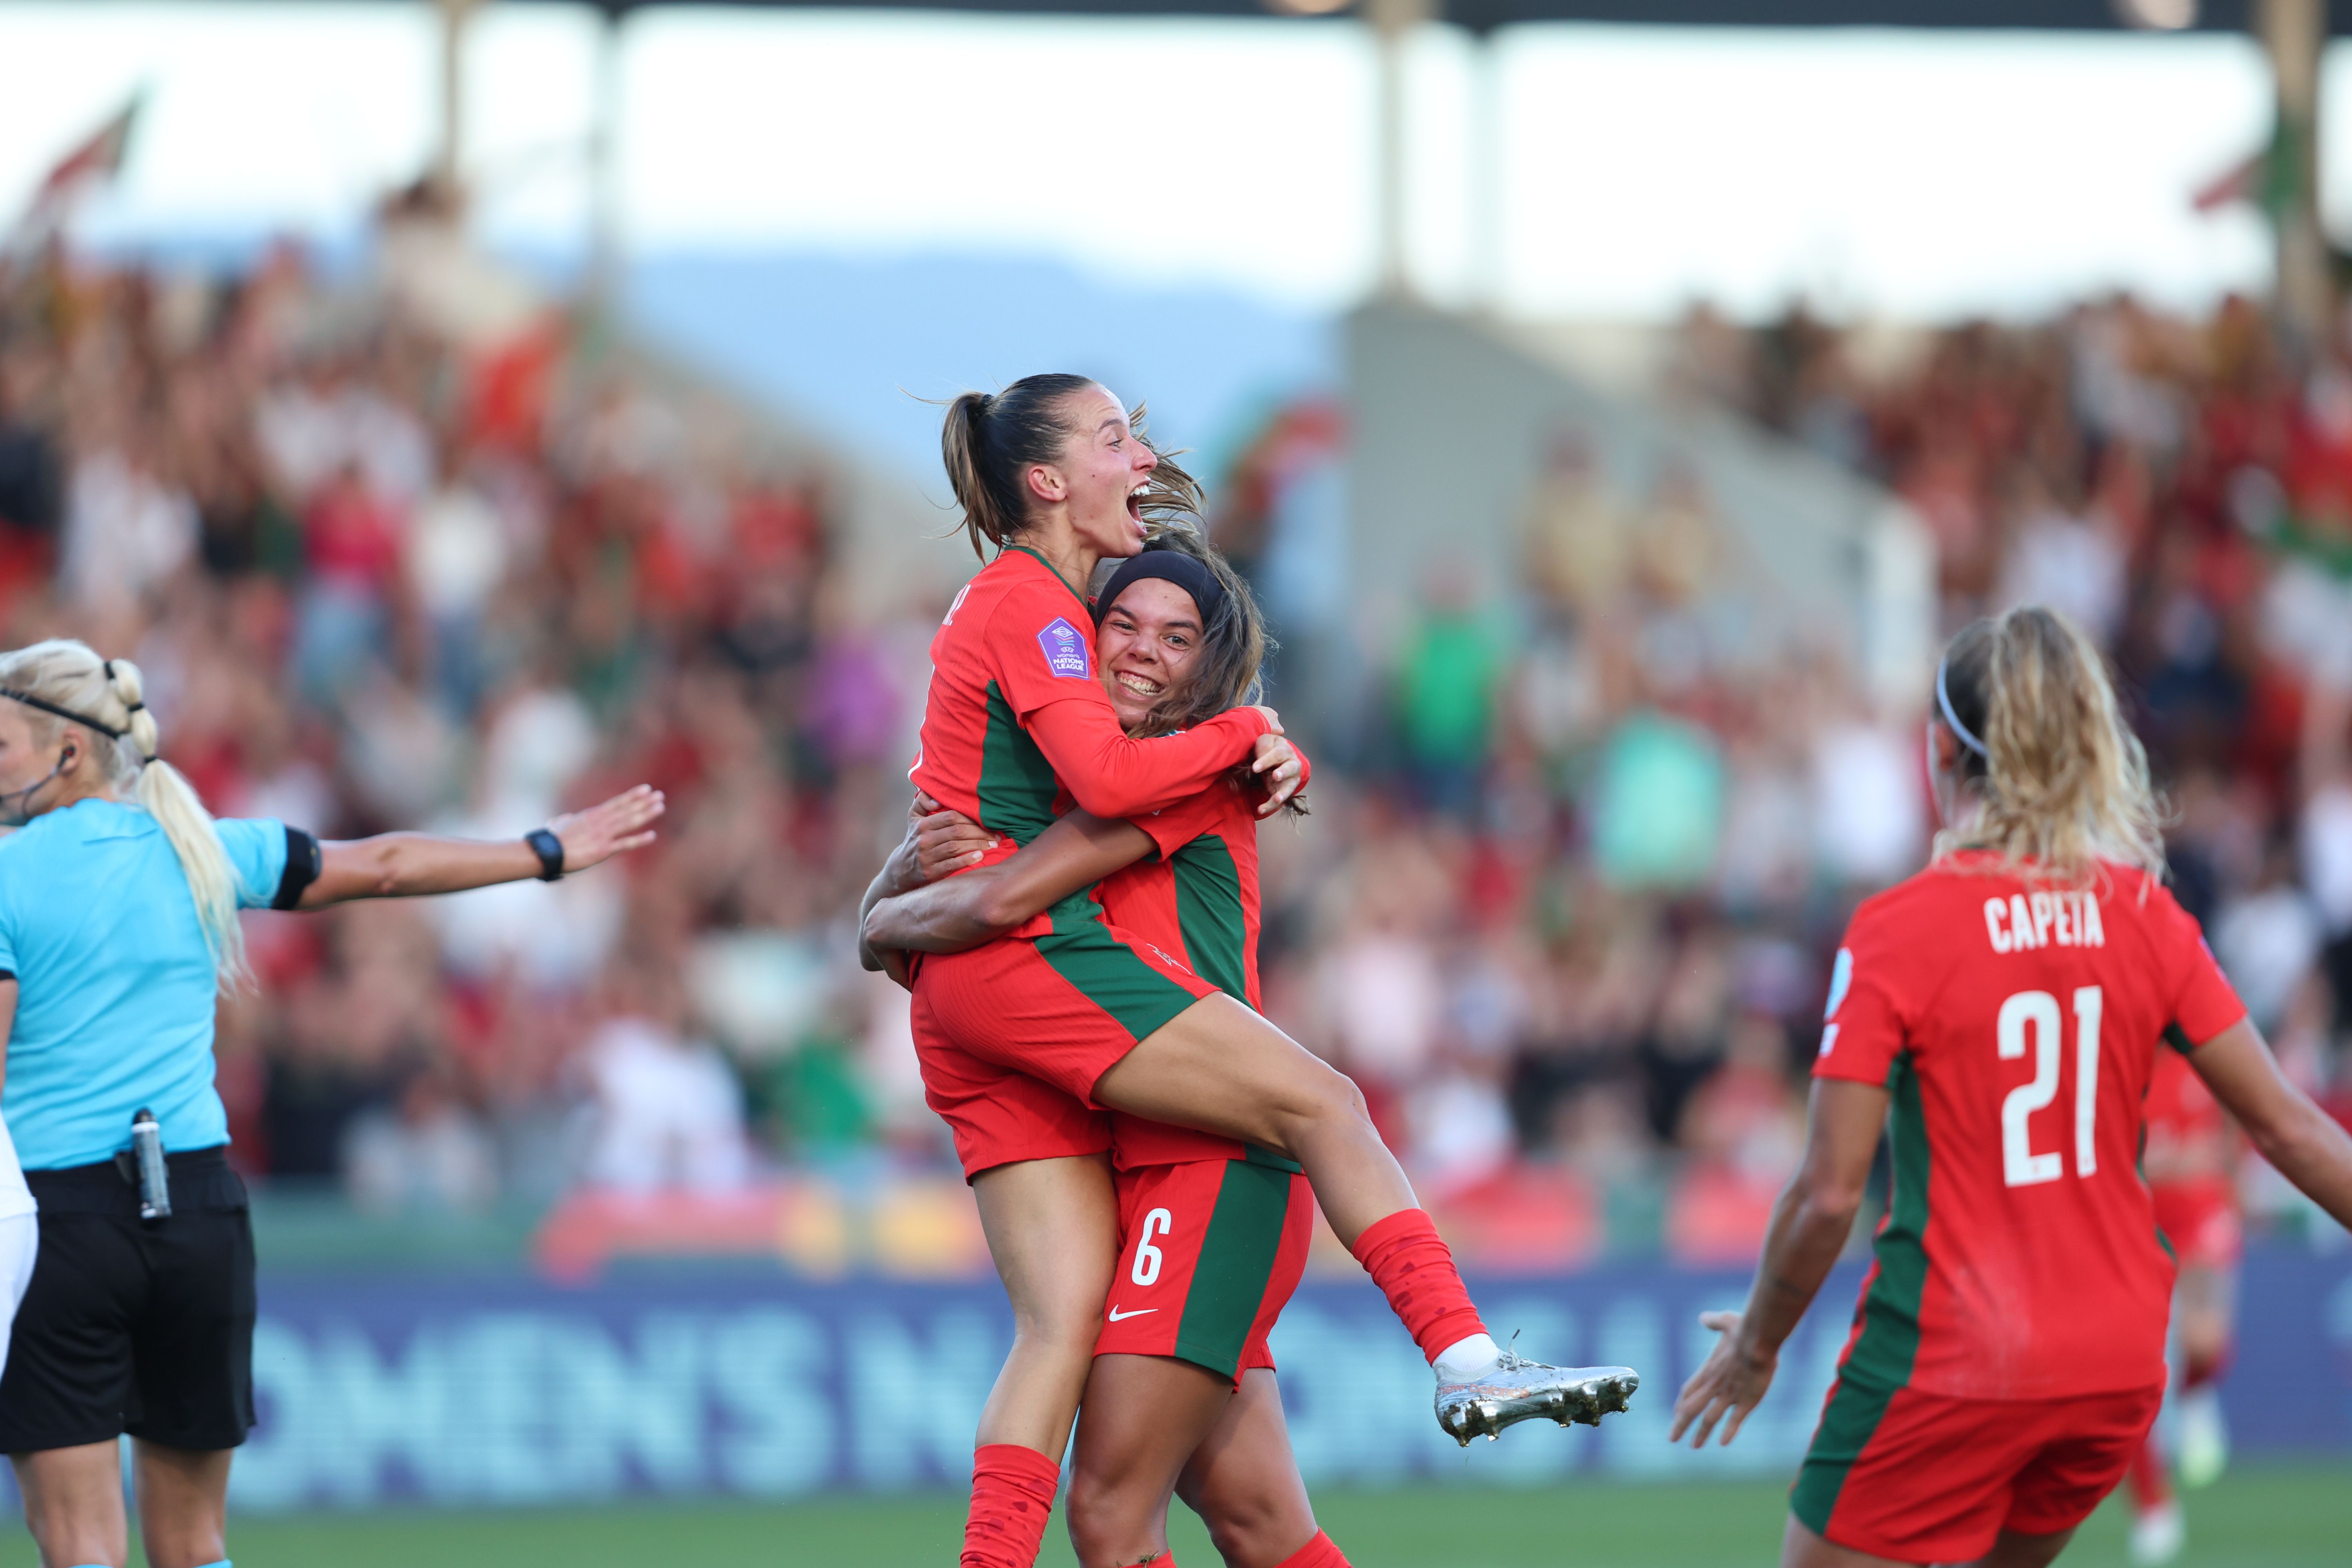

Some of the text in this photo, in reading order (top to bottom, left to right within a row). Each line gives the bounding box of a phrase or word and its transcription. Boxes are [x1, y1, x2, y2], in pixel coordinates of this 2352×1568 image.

[1984, 890, 2105, 954] CAPETA
[1997, 985, 2103, 1187] 21
[1132, 1208, 1171, 1286] 6
[1438, 1383, 1530, 1399] new balance
